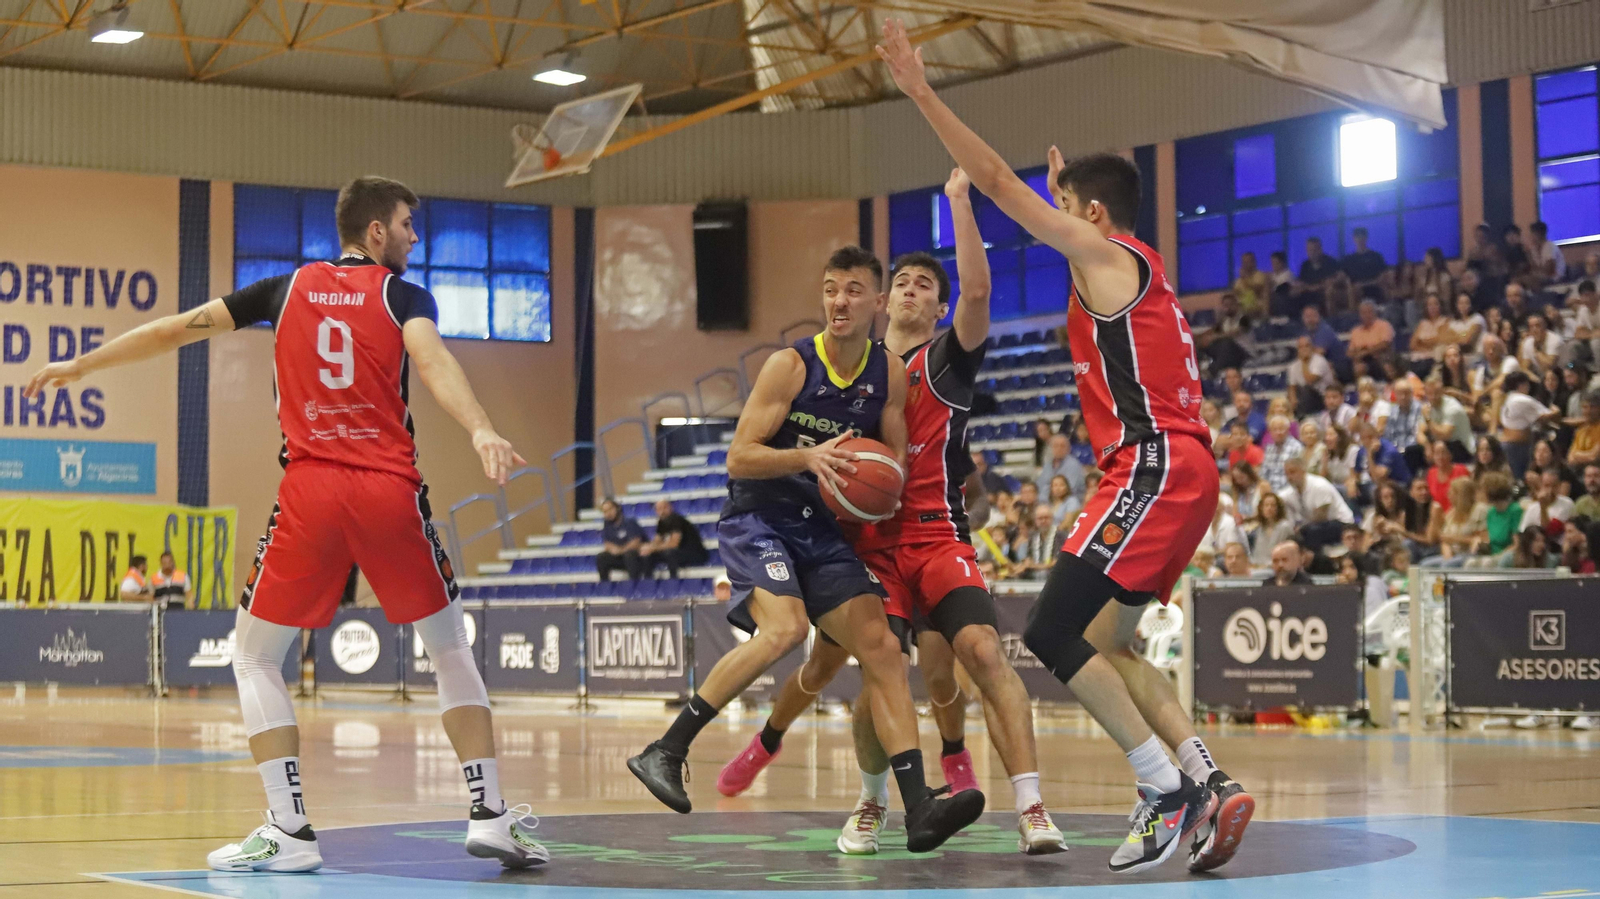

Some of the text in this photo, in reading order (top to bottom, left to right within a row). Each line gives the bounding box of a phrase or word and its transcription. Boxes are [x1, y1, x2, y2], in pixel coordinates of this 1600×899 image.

[0, 261, 158, 312] ORTIVO
[308, 291, 366, 306] URDIAIN
[3, 323, 105, 365] D DE
[317, 316, 355, 390] 9
[3, 385, 106, 430] IRAS
[1068, 512, 1088, 539] 5
[593, 625, 677, 667] LAPITANZA
[1267, 601, 1328, 661] ice
[39, 646, 104, 662] Manhattan
[501, 643, 535, 669] PSOE
[1496, 658, 1600, 680] ASESORES
